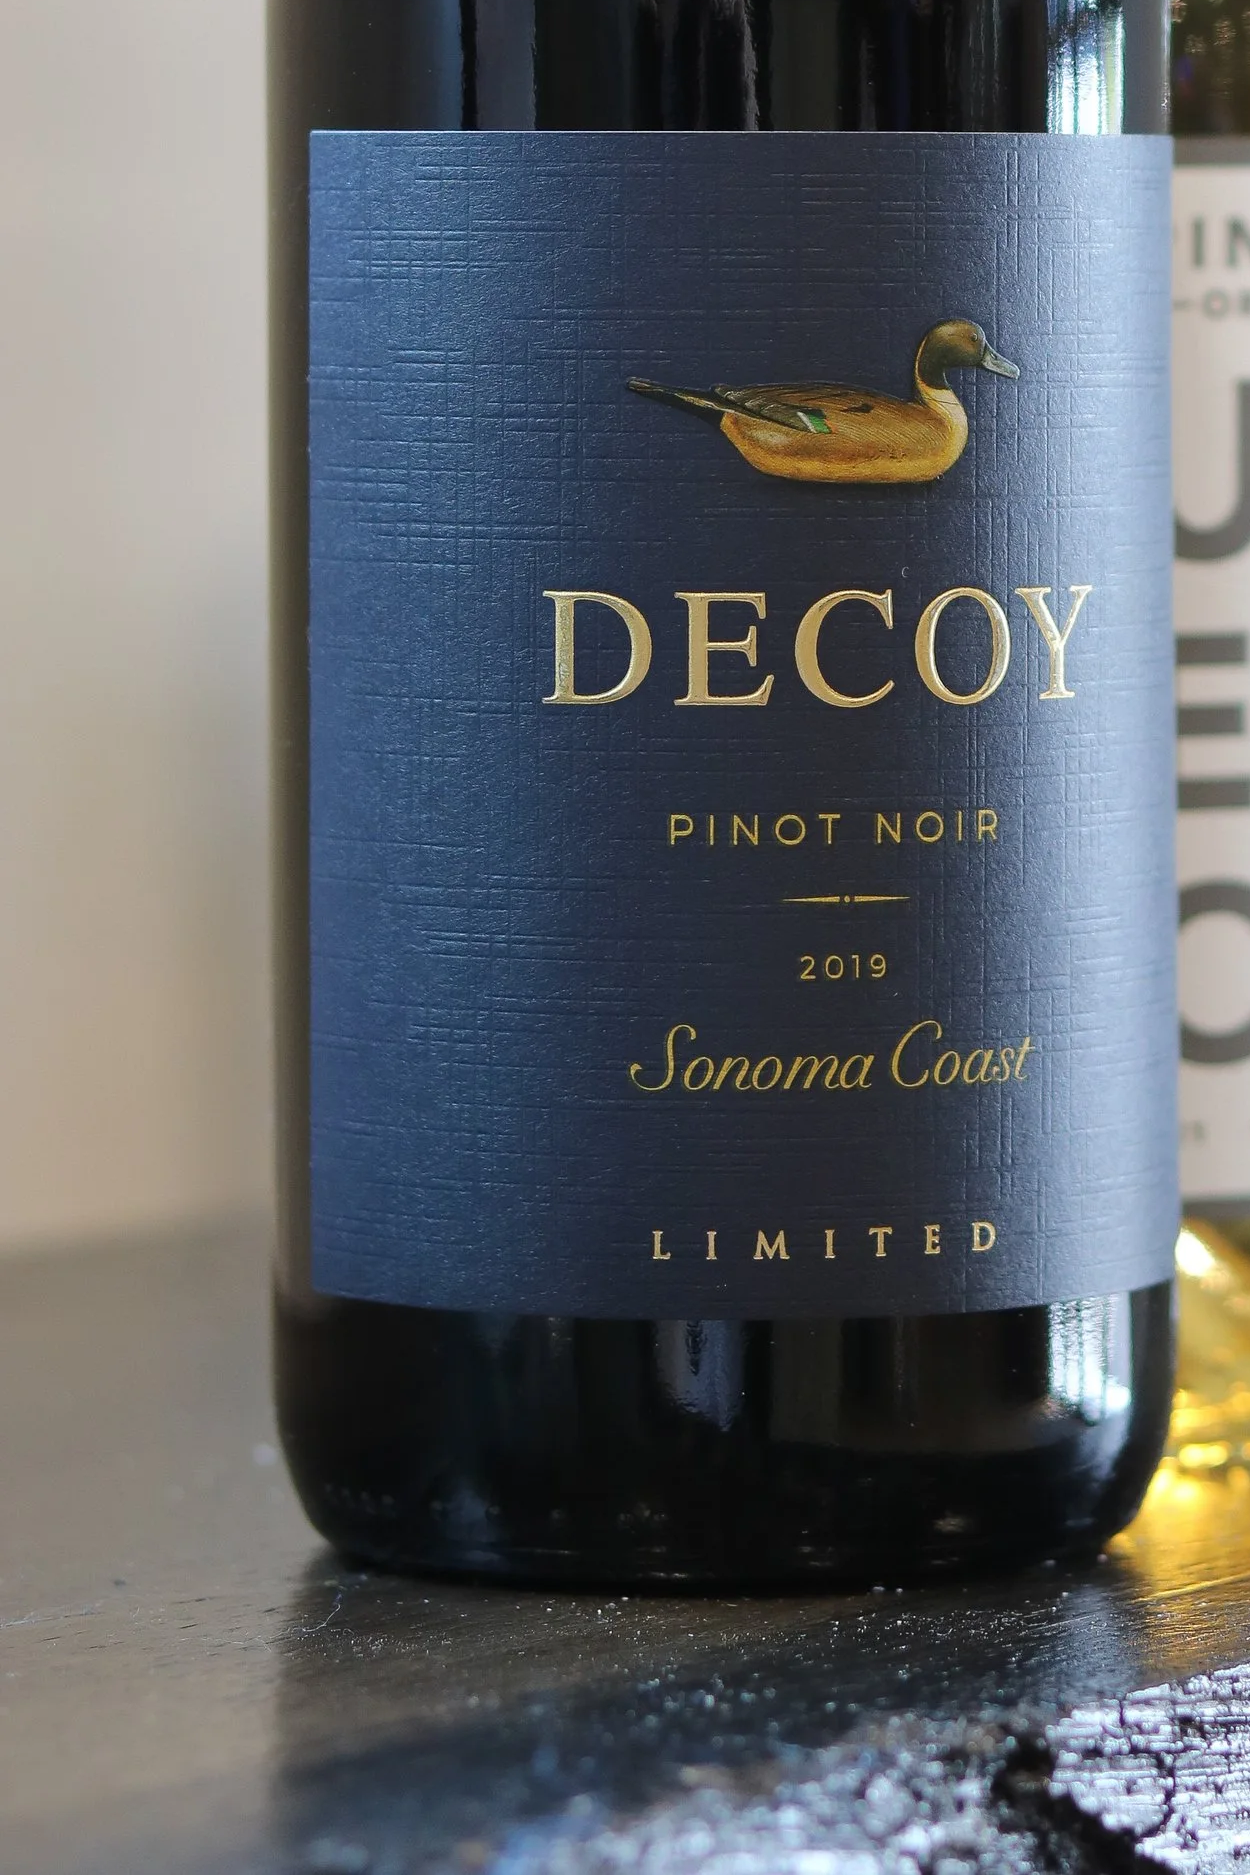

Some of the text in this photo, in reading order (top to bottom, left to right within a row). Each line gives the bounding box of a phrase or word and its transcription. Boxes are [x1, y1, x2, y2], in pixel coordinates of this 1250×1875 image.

[542, 584, 1093, 709] DECOY
[668, 808, 1000, 847] PINOT NOIR
[799, 953, 888, 982] 2019
[629, 1020, 1034, 1090] Sonoma Coast
[652, 1220, 997, 1262] LIMITED
